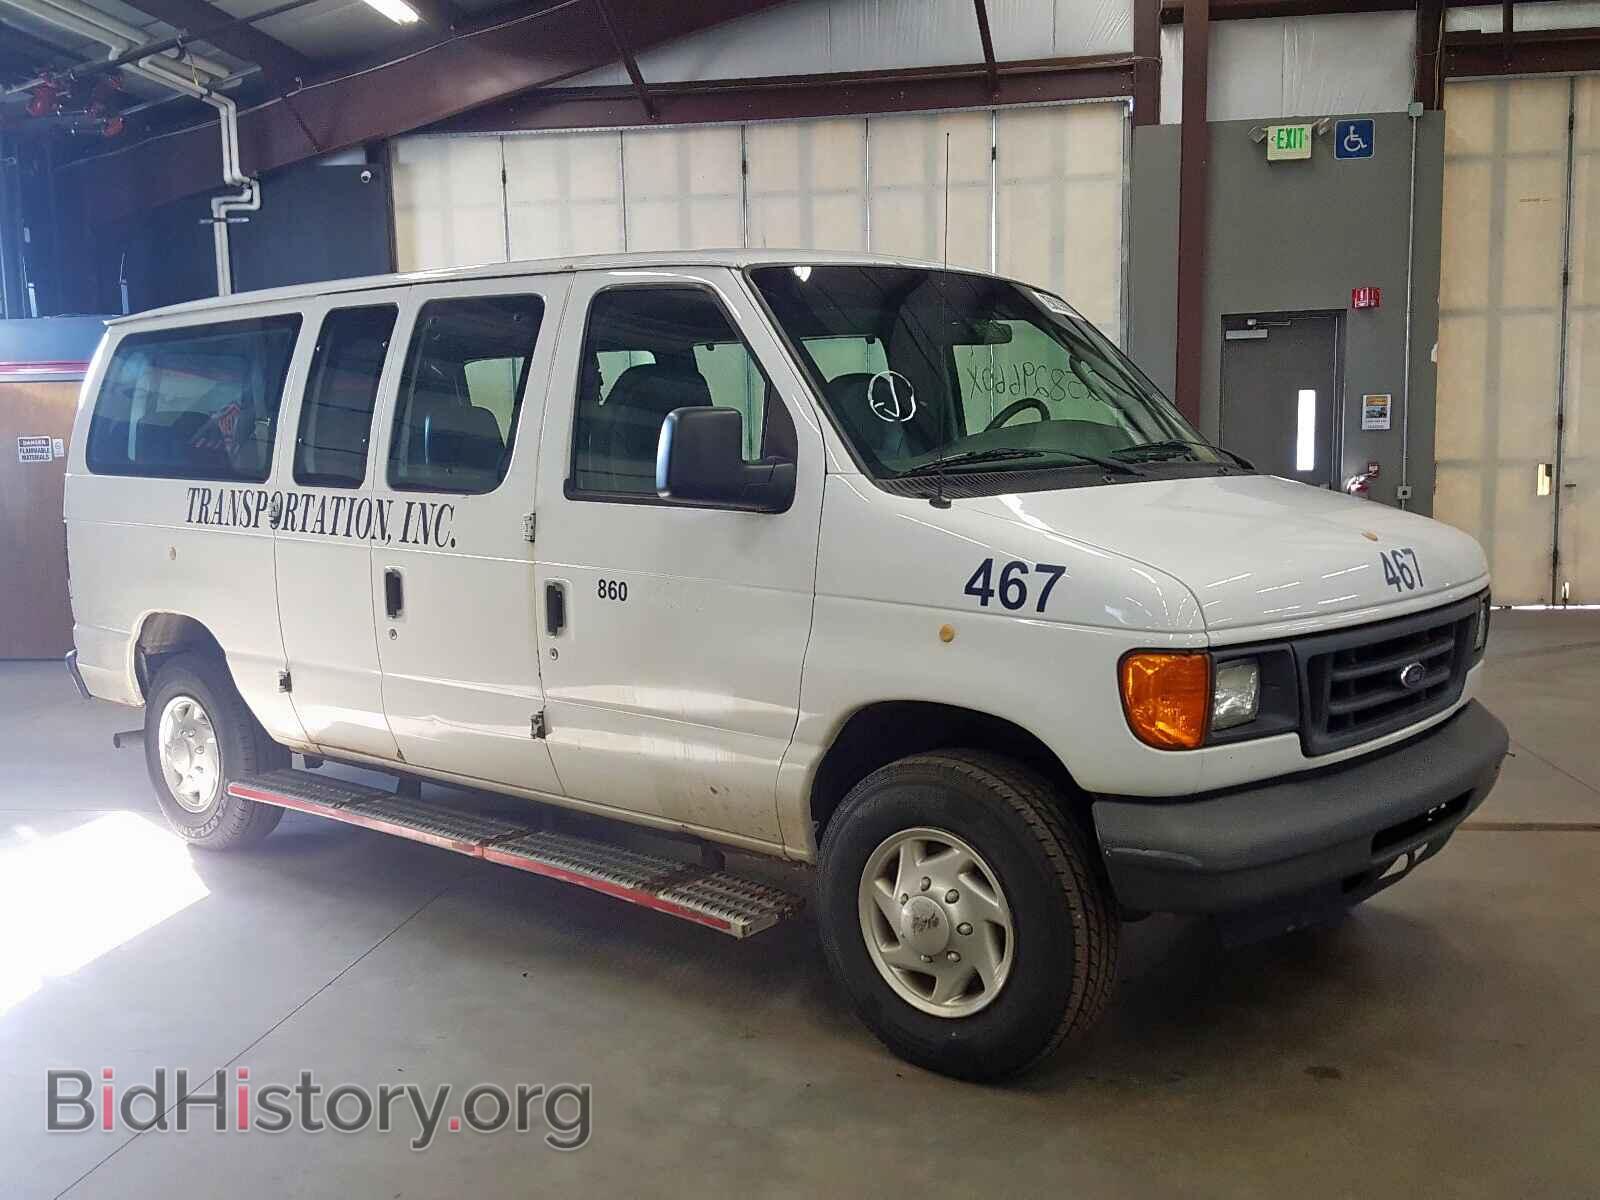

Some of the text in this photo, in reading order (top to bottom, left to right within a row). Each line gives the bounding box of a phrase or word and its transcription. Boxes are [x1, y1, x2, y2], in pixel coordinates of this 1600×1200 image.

[1276, 127, 1305, 150] EXIT
[186, 487, 457, 548] TRANSPORTATION, INC.
[597, 579, 628, 602] 860
[964, 558, 1067, 613] 467
[1379, 548, 1424, 593] 467
